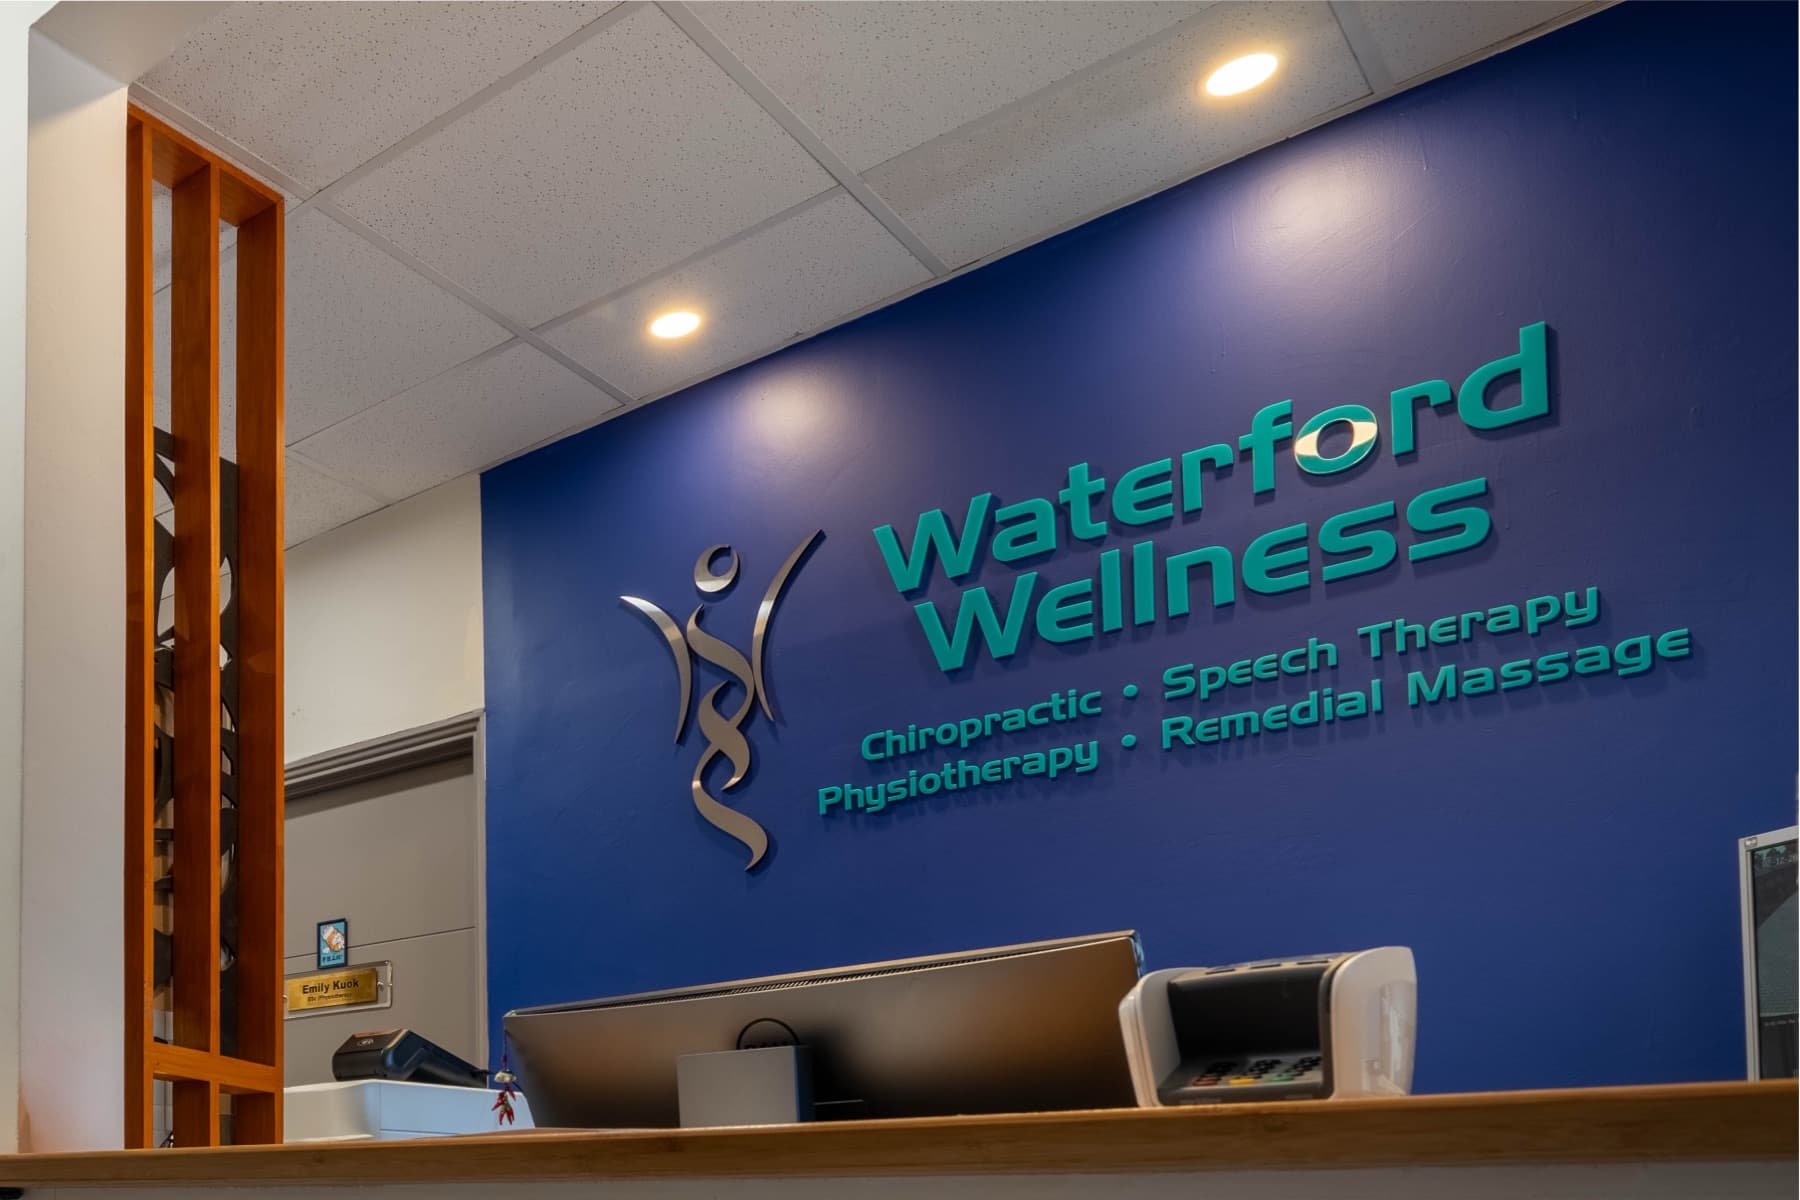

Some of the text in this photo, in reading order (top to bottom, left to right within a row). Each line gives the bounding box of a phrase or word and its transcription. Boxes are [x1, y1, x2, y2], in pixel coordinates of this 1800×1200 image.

[872, 320, 1549, 593] Waterford
[913, 475, 1492, 673] Wellness
[817, 627, 1692, 816] Physiotherapy Remedial Massage
[860, 585, 1600, 761] Chiropractic Speech Therapy
[302, 979, 360, 995] Emily Kuok
